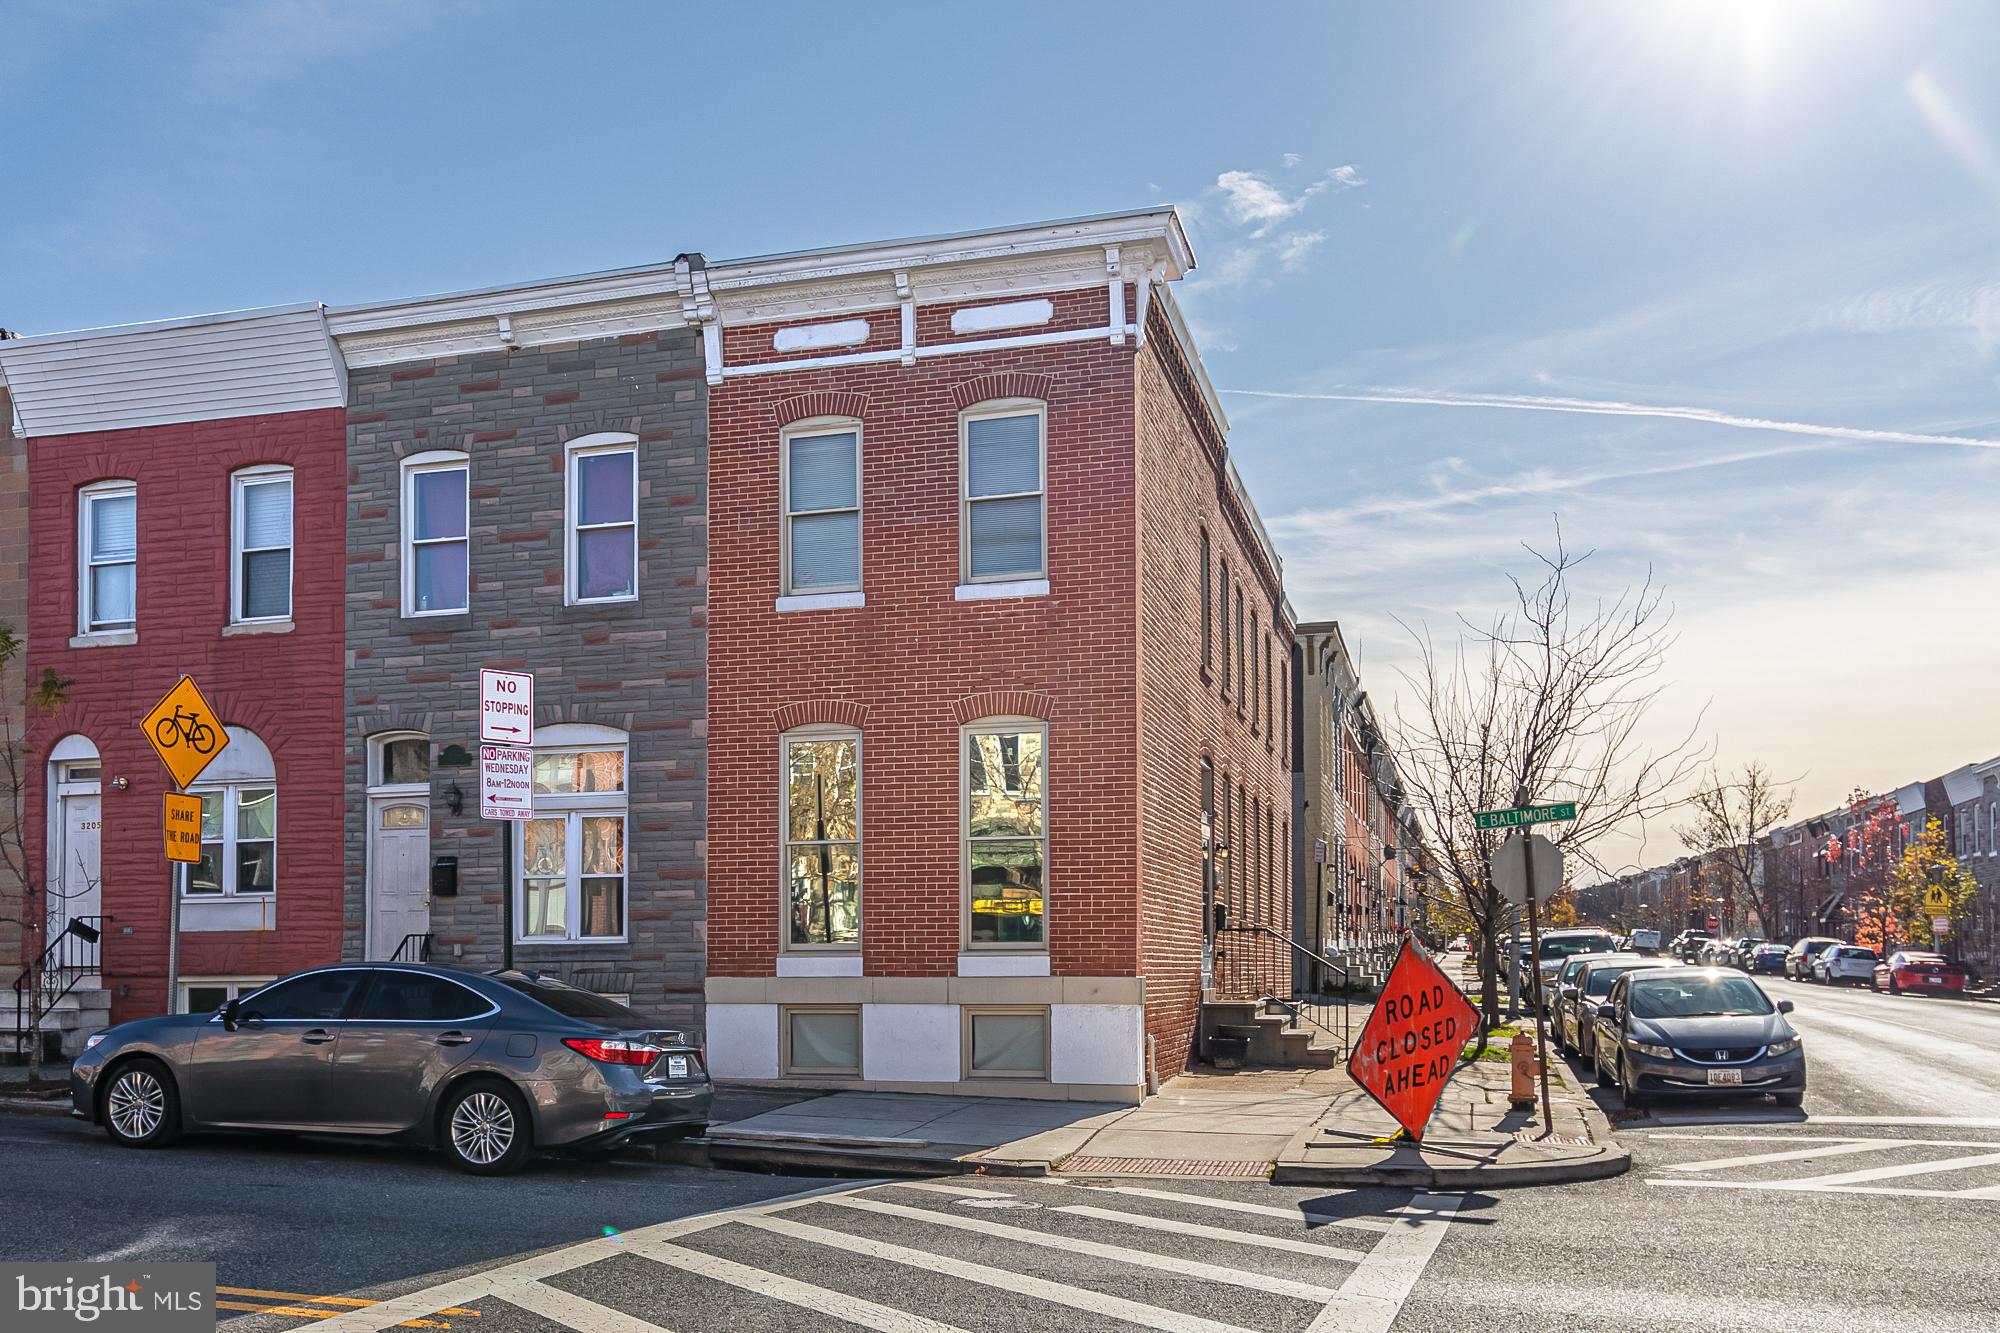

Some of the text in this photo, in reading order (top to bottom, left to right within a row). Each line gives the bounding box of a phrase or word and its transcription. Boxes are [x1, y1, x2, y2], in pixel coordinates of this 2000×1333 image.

[496, 679, 517, 694] NO
[484, 700, 529, 716] STOPPING
[482, 748, 530, 763] NO PARKING
[485, 763, 529, 775] WEDNESDAY
[486, 777, 530, 789] 8AM-12NOON
[171, 809, 195, 823] SHARE
[484, 808, 531, 818] CARS TOWED AWAY
[1480, 807, 1570, 828] E BALTIMORE ST
[81, 821, 102, 830] 3205
[166, 829, 200, 845] THE ROAD
[1384, 985, 1445, 1025] ROAD
[1376, 1017, 1457, 1065] CLOSED
[1384, 1055, 1450, 1099] AHEAD
